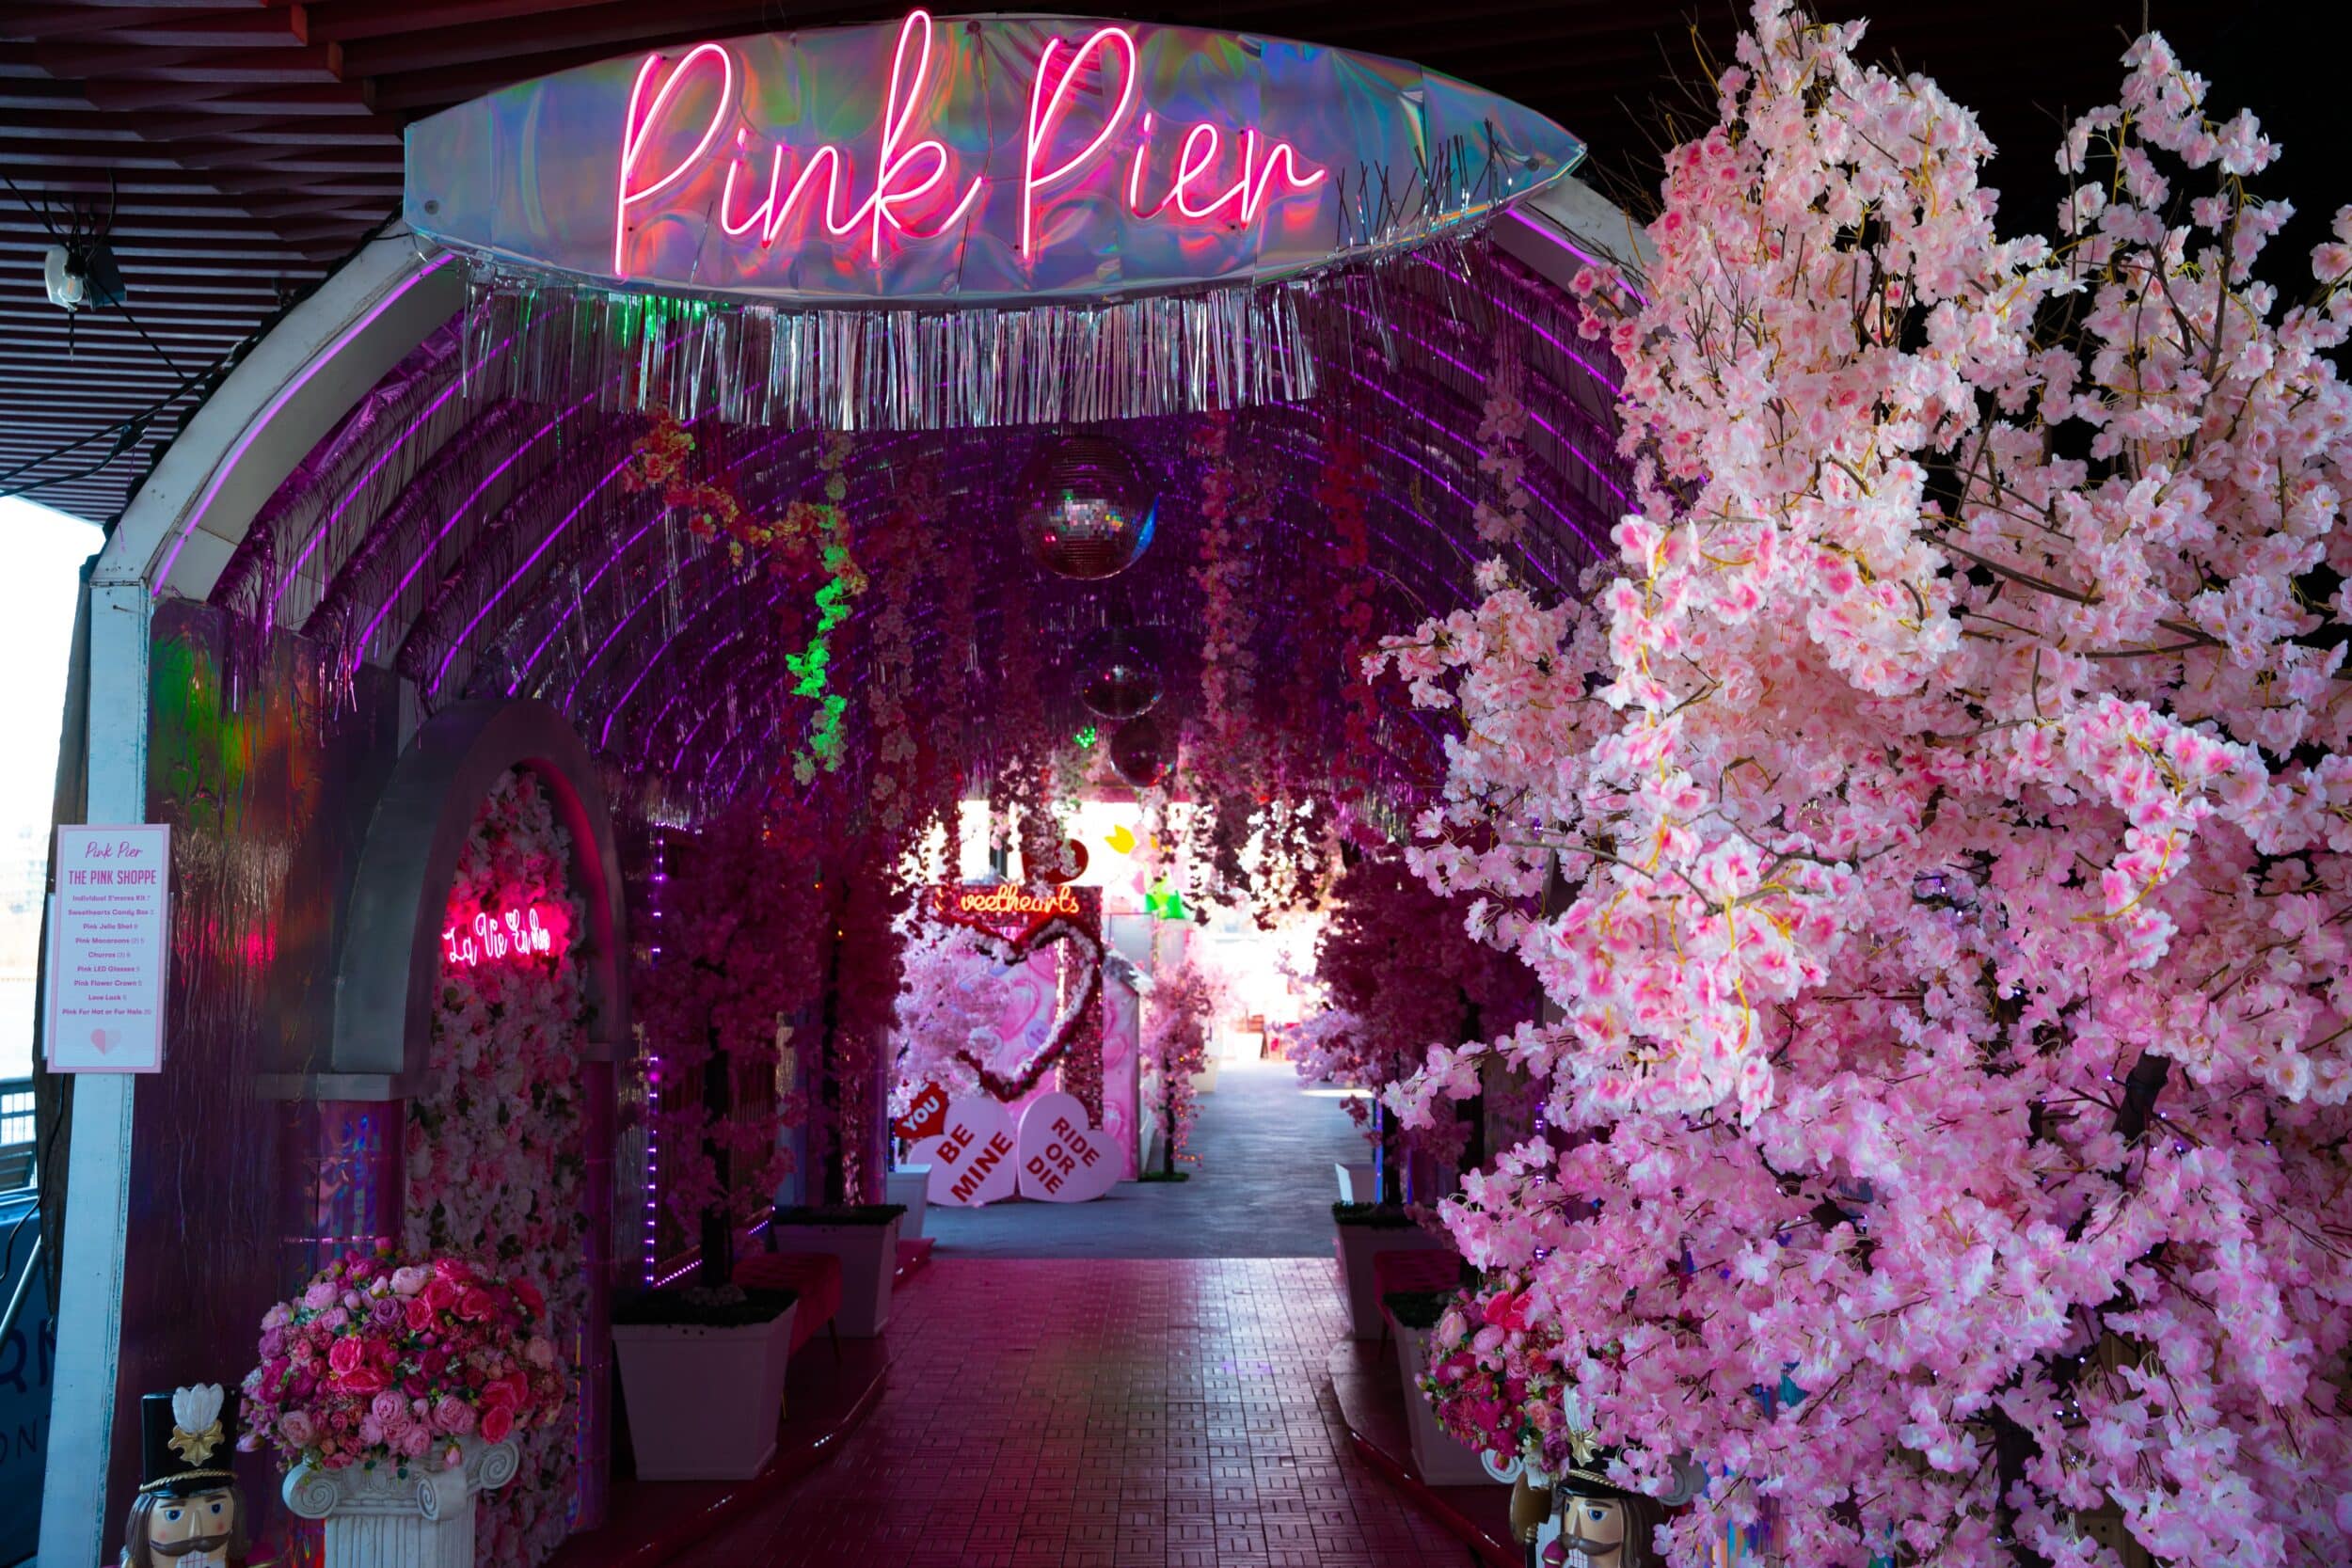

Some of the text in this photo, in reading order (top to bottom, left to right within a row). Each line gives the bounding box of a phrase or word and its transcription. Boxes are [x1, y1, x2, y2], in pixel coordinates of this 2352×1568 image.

[613, 8, 1327, 277] Pink Pier
[85, 841, 143, 860] Pink Pier
[68, 869, 157, 885] THE PINK SHOPPE
[112, 909, 135, 918] Candy
[441, 927, 478, 967] La
[474, 911, 508, 958] Vie
[78, 1007, 89, 1016] Fur
[91, 1007, 103, 1016] Hat
[104, 1007, 113, 1016] or
[114, 1007, 126, 1016] Fur
[901, 1095, 940, 1132] YOU
[936, 1123, 976, 1165] BE
[1045, 1143, 1076, 1176] OR
[1051, 1117, 1101, 1168] RIDE
[950, 1132, 1014, 1203] MINE
[1026, 1155, 1065, 1195] DIE
